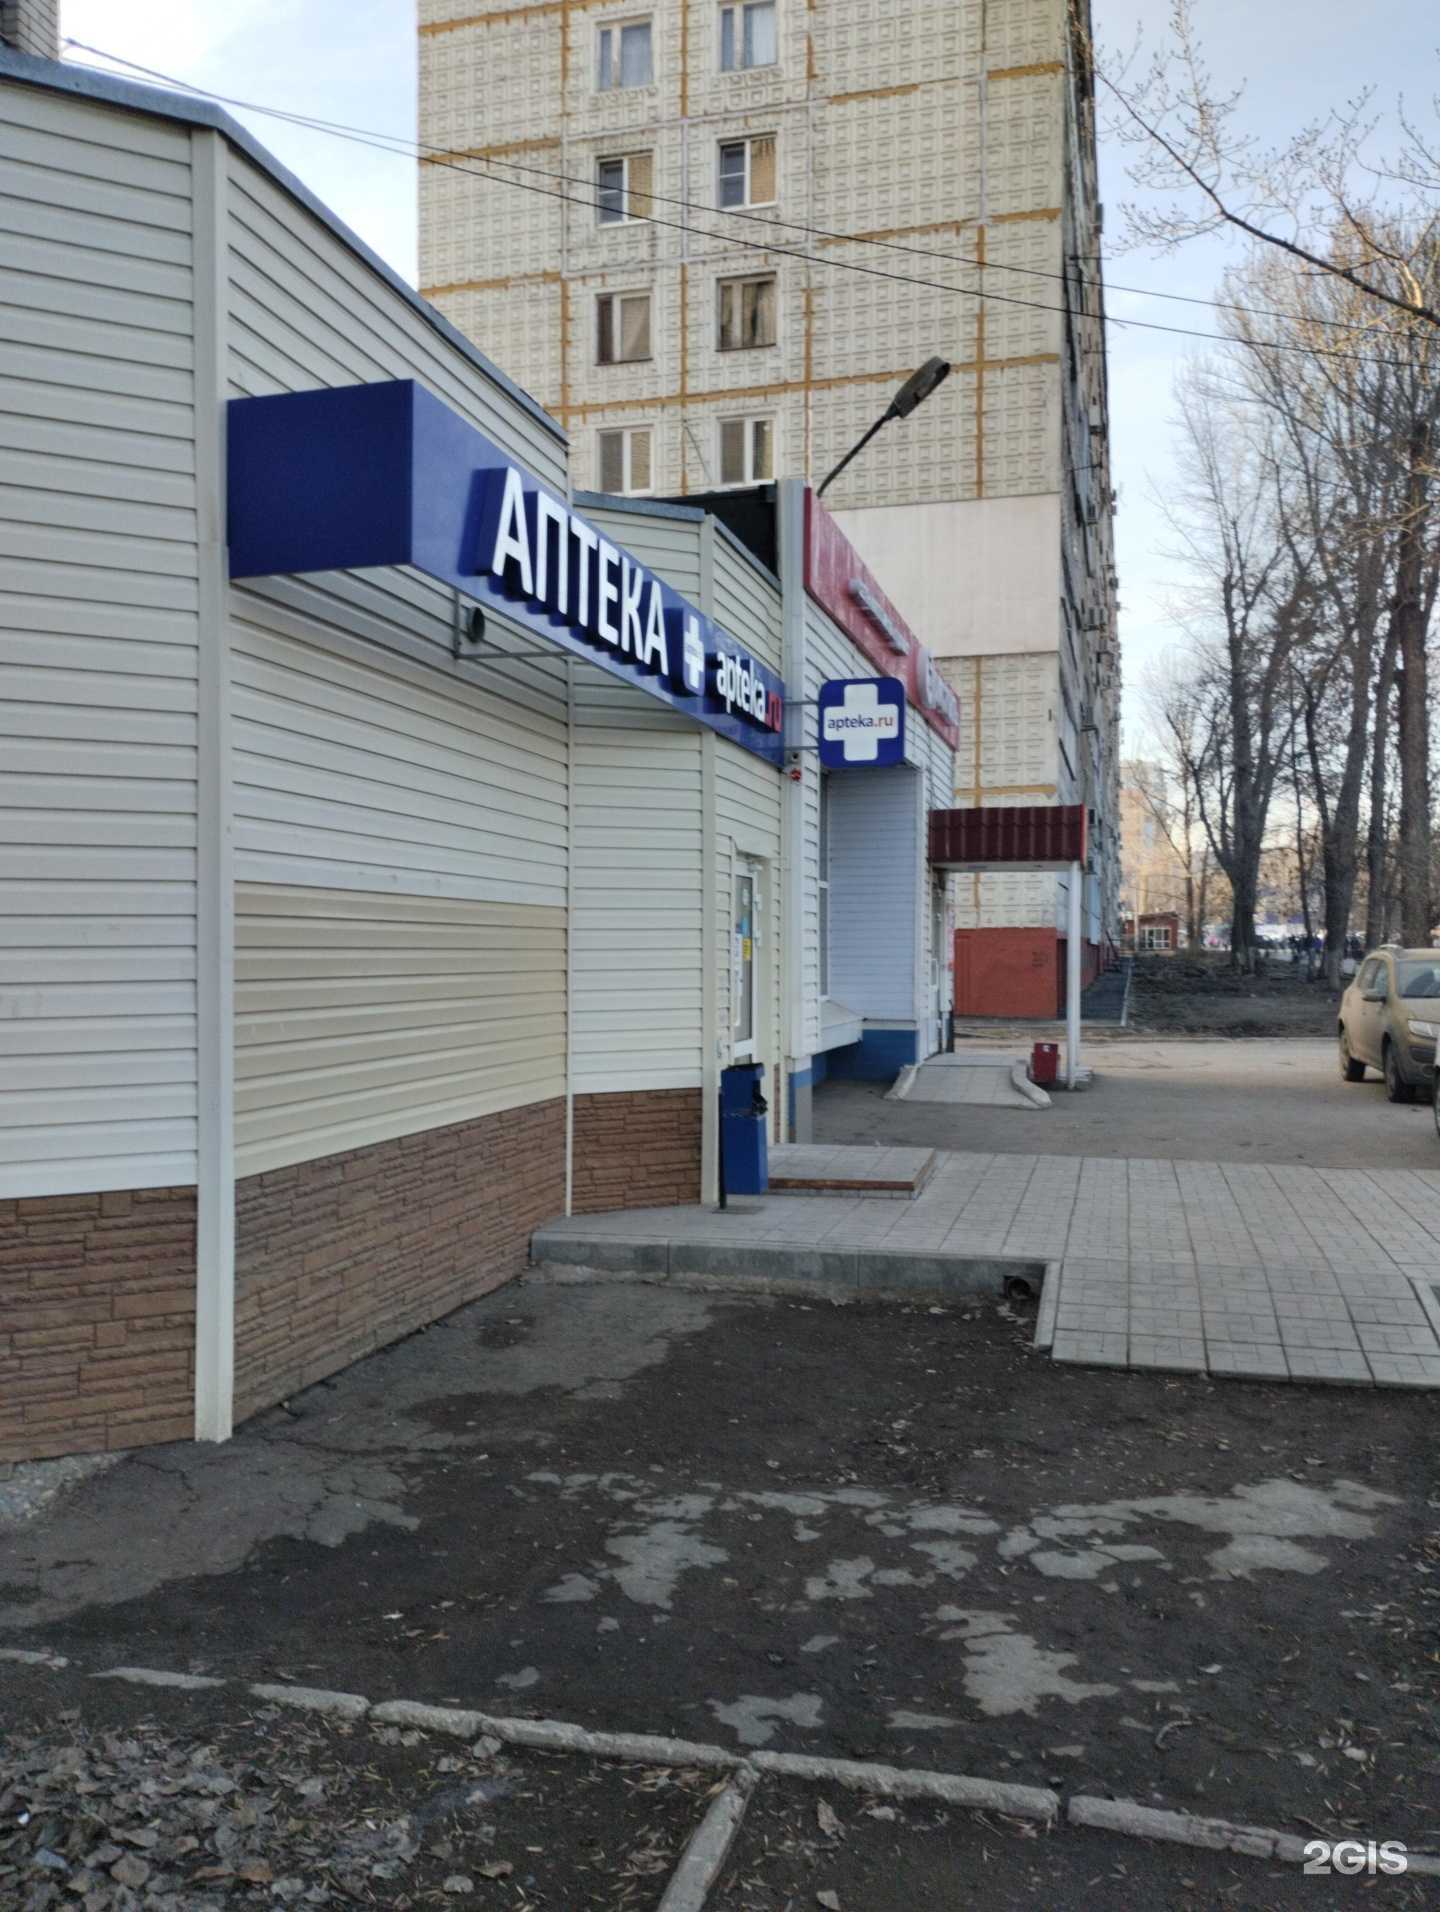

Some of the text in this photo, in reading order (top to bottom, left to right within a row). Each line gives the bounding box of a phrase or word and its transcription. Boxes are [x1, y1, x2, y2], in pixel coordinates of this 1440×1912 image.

[492, 466, 669, 676] АПТЕКА
[716, 651, 782, 733] apteka.ru
[827, 714, 894, 731] apteka.ru
